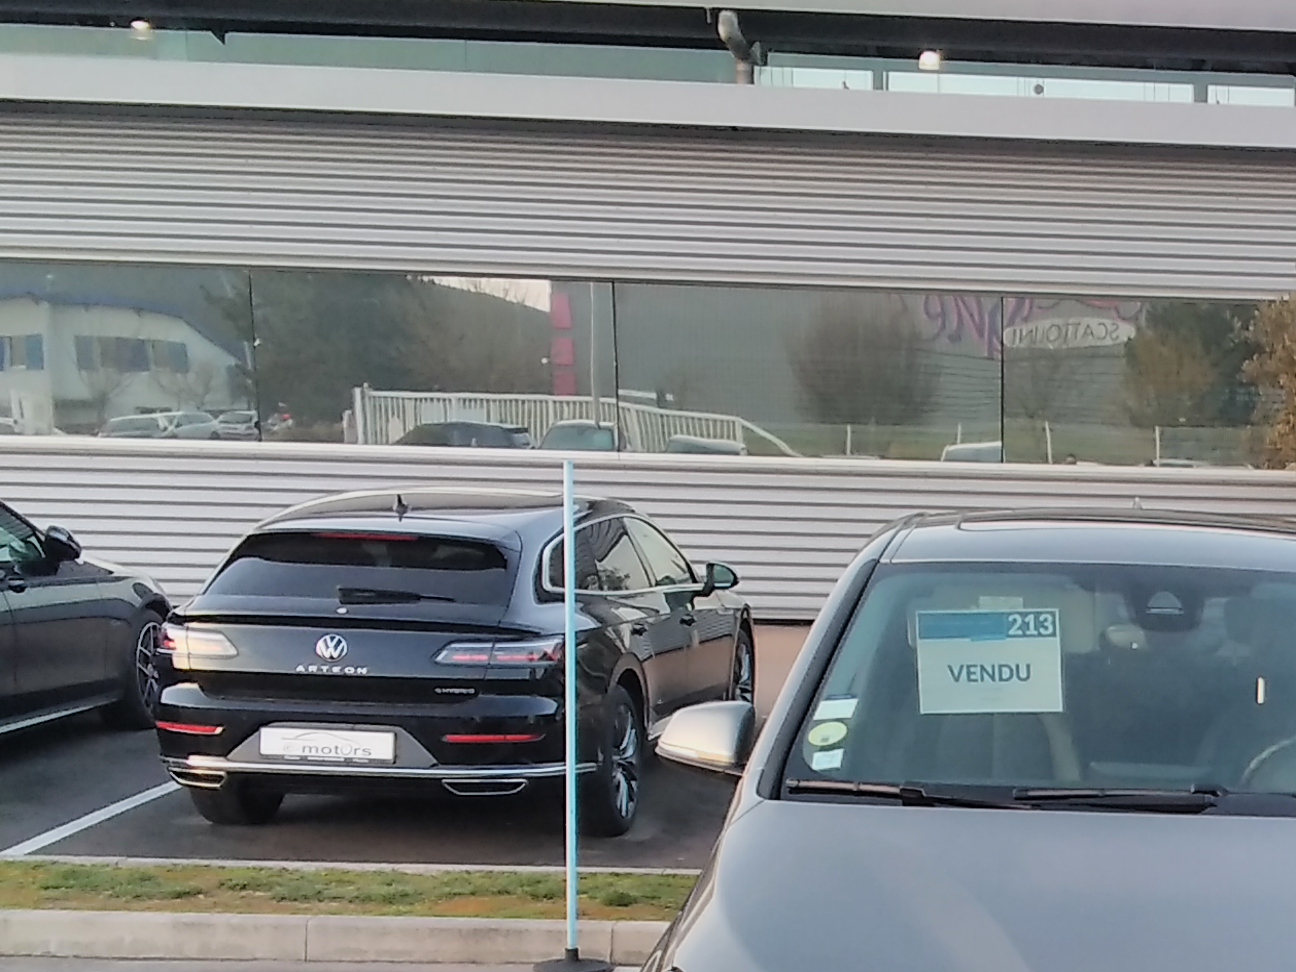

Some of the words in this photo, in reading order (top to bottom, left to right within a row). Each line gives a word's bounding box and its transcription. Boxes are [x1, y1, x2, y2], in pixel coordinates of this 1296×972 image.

[1007, 613, 1054, 636] 213
[295, 664, 368, 675] ARTEON
[947, 663, 1032, 684] VENDU
